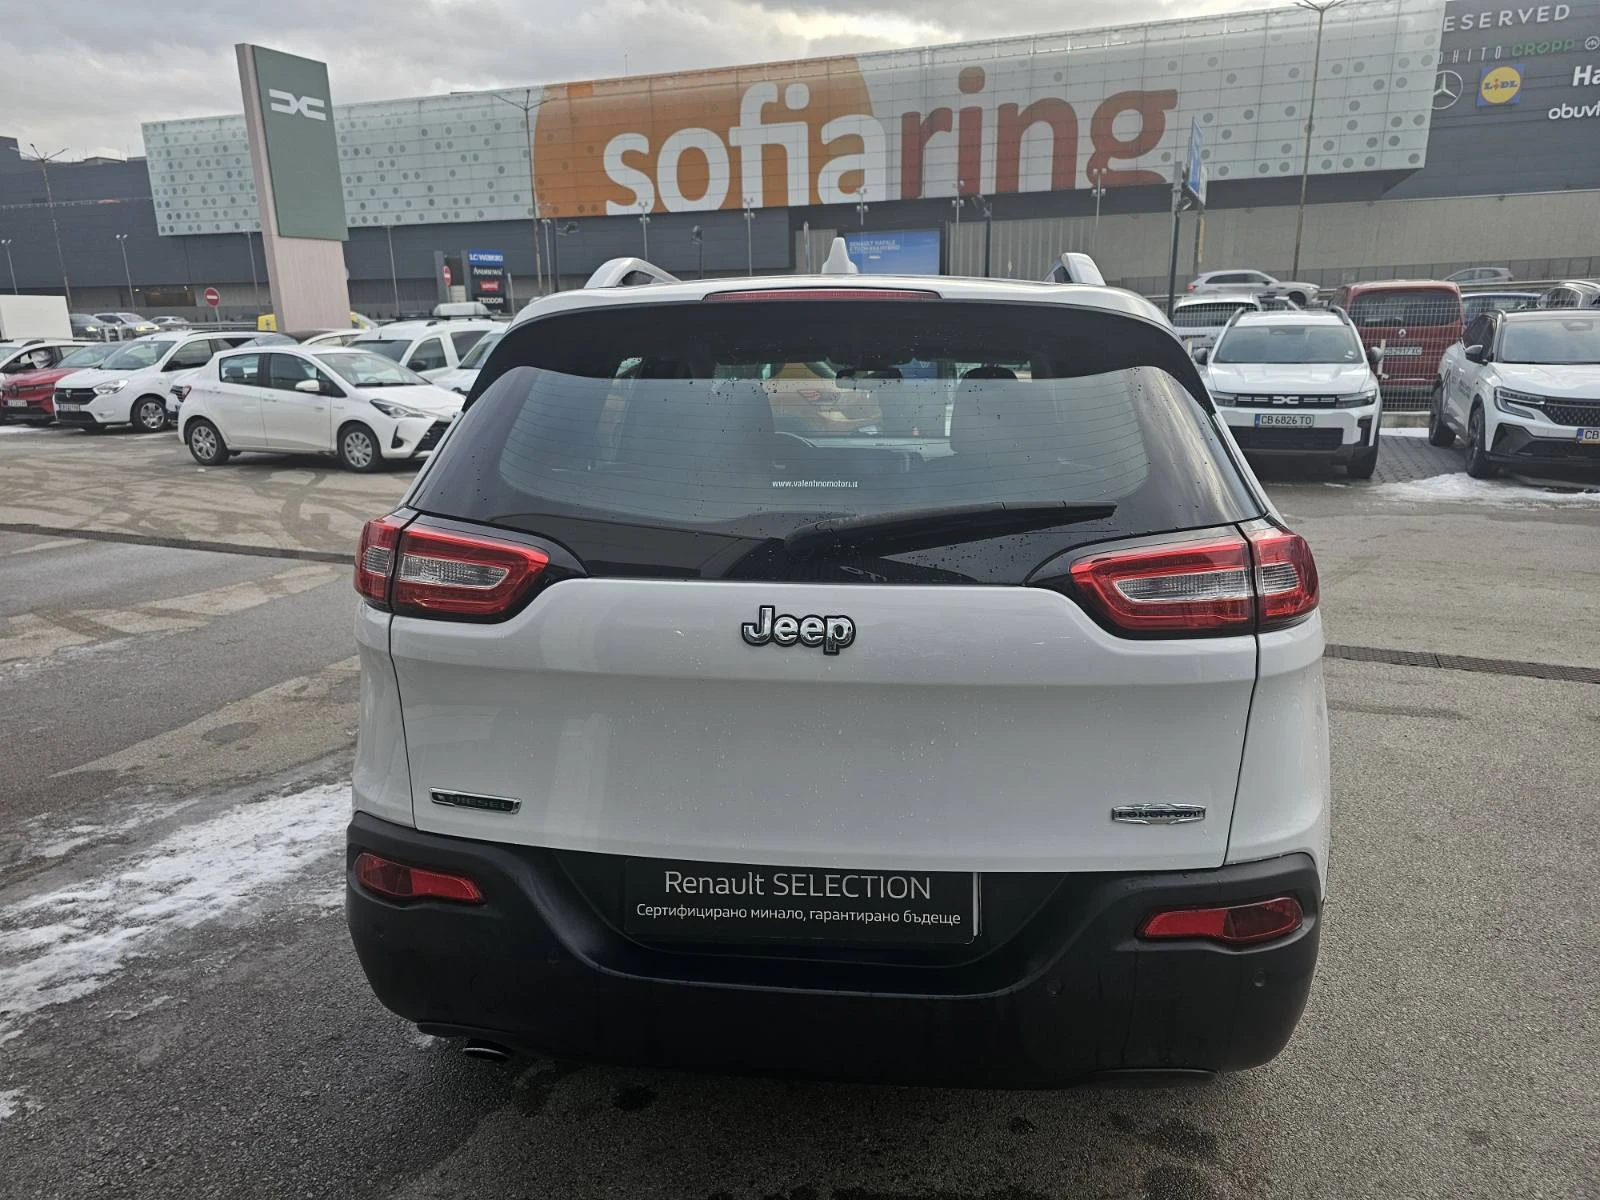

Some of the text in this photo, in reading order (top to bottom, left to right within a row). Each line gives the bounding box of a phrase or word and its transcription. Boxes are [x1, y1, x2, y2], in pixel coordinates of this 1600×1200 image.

[1261, 416, 1274, 425] CB
[1274, 415, 1298, 425] 6826
[1584, 430, 1600, 440] CB
[742, 605, 856, 655] Jeep
[664, 870, 931, 900] Renault SELECTION
[636, 903, 961, 926] Сертифицирано минало, гарантирано бъдеще
